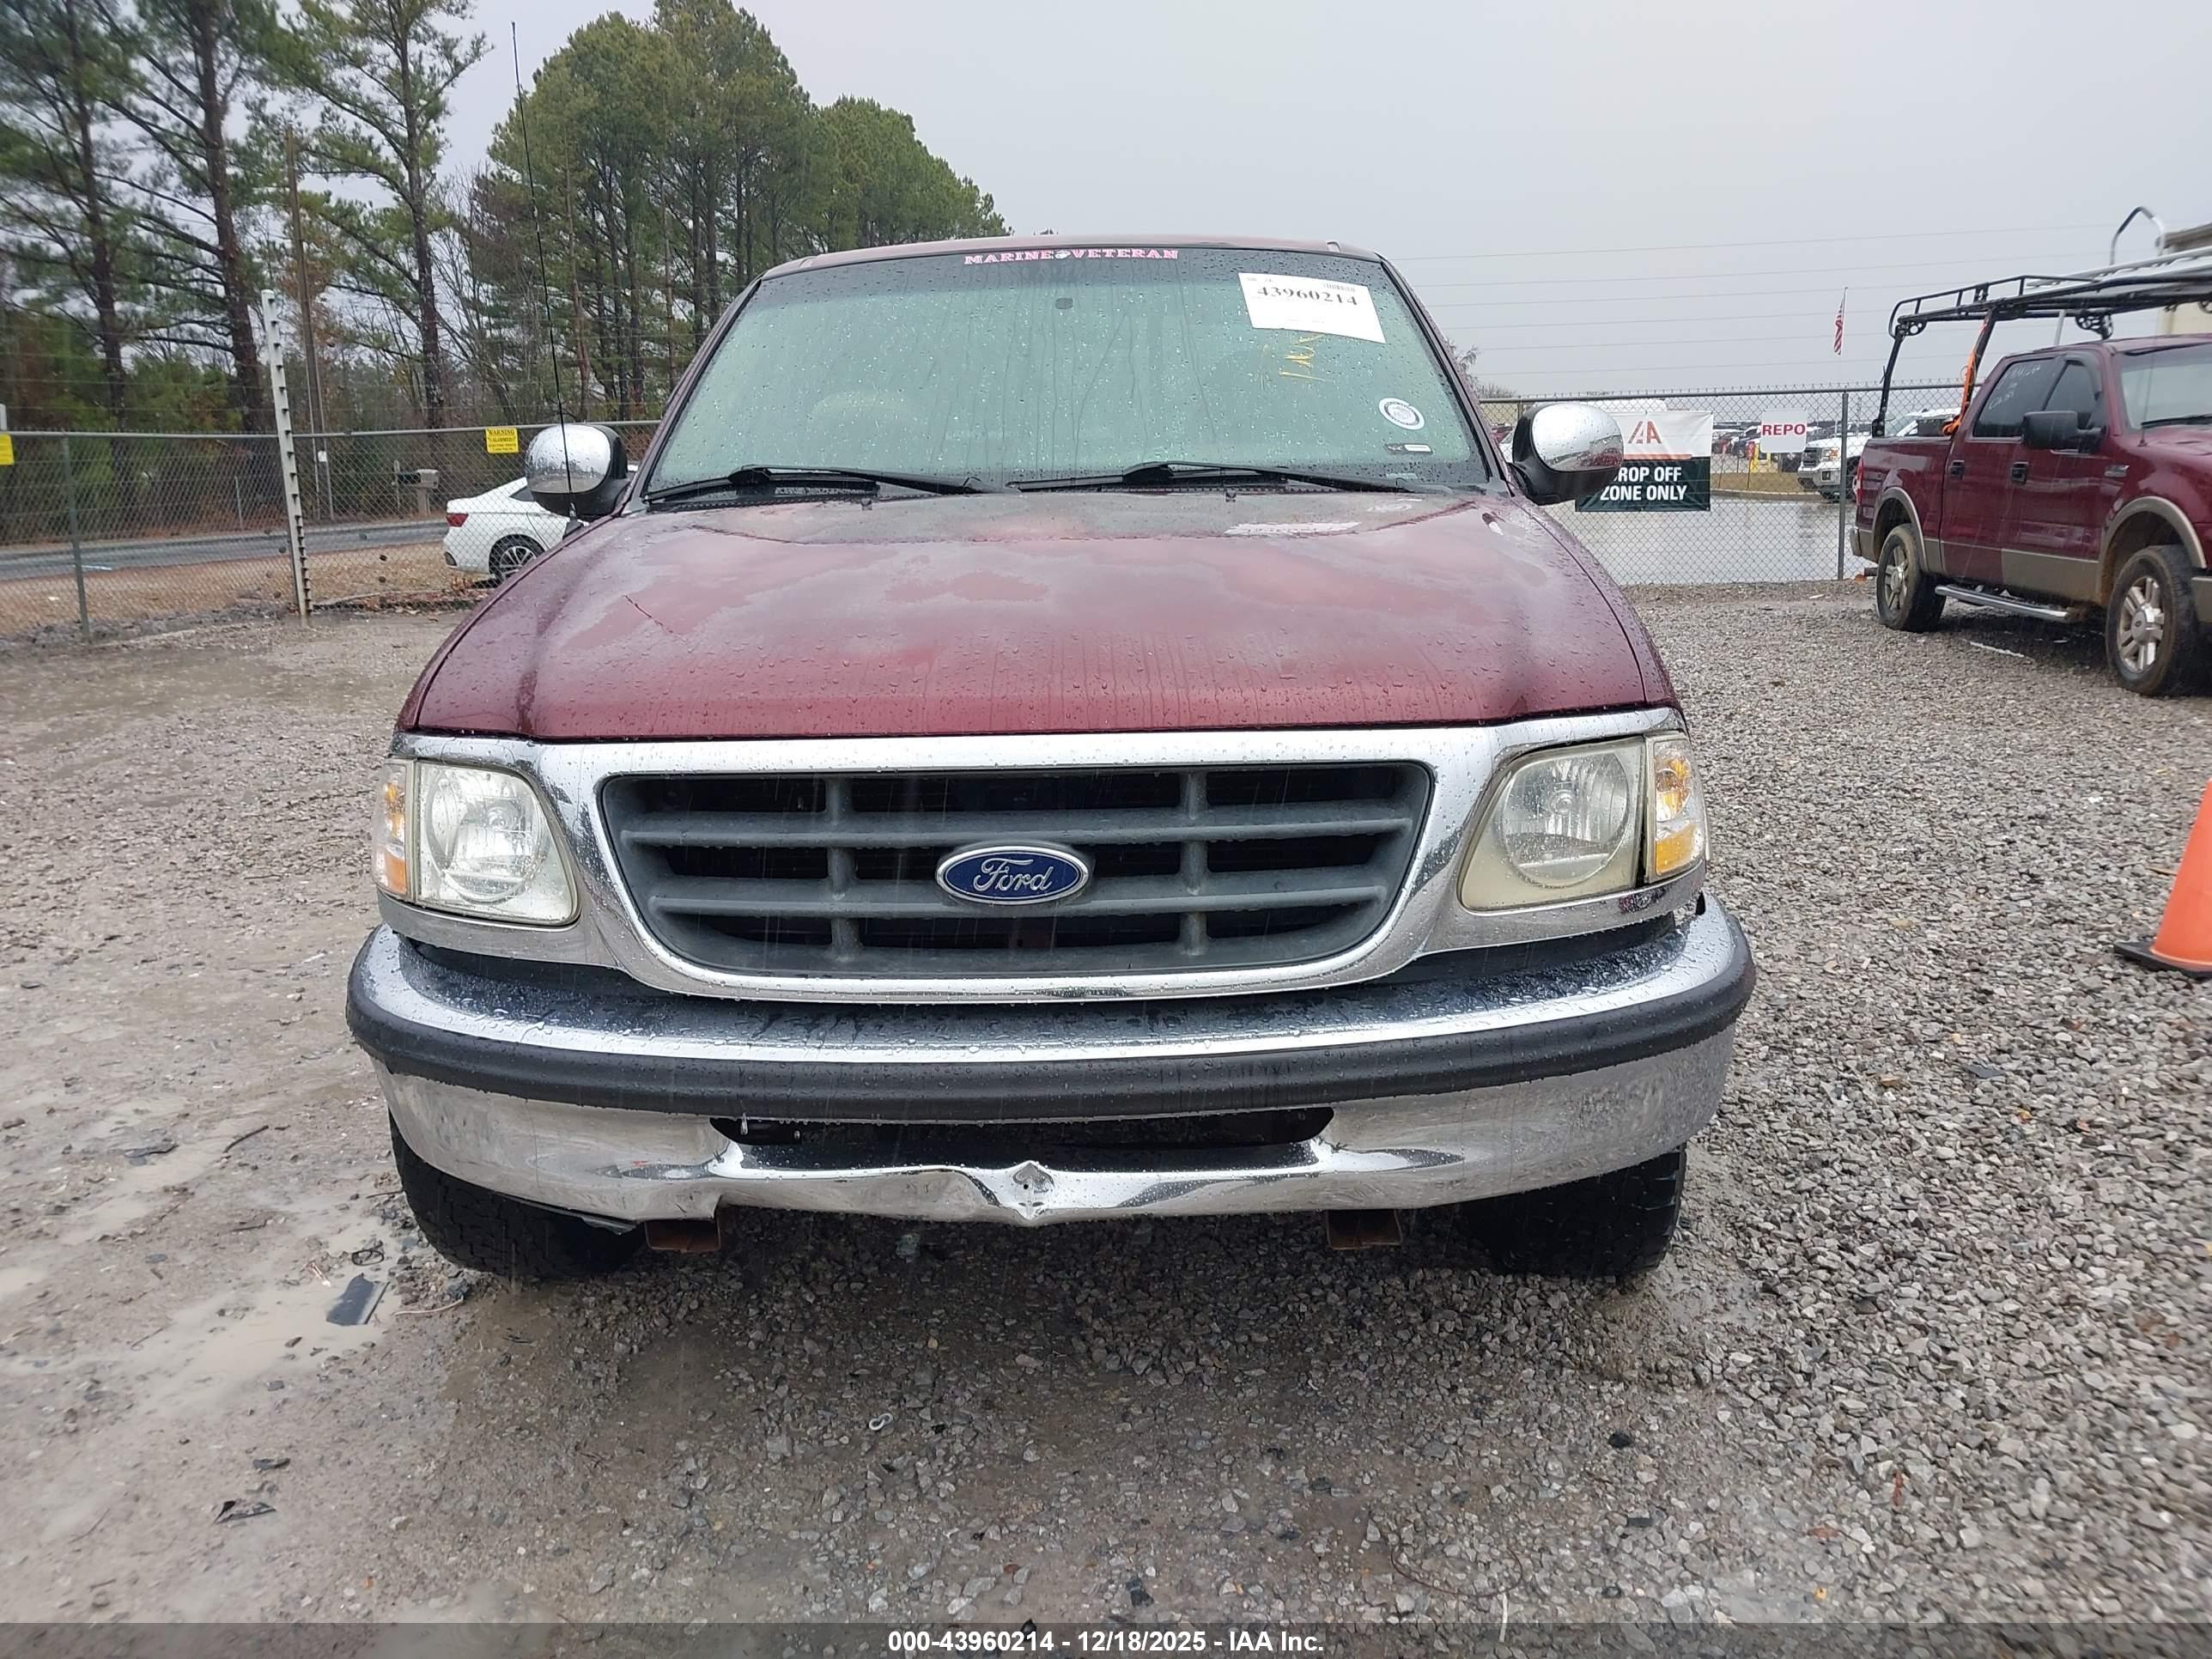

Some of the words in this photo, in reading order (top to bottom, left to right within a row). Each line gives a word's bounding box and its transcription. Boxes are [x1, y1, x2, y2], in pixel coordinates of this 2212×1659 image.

[963, 250, 1054, 265] MARINE
[1071, 248, 1179, 260] VETERAN
[1256, 286, 1358, 306] 43960214
[1762, 423, 1806, 435] REPO
[1613, 466, 1650, 483] ROP
[1654, 466, 1682, 483] OFF
[1646, 484, 1688, 501] ONLY
[973, 858, 1054, 891] Ford
